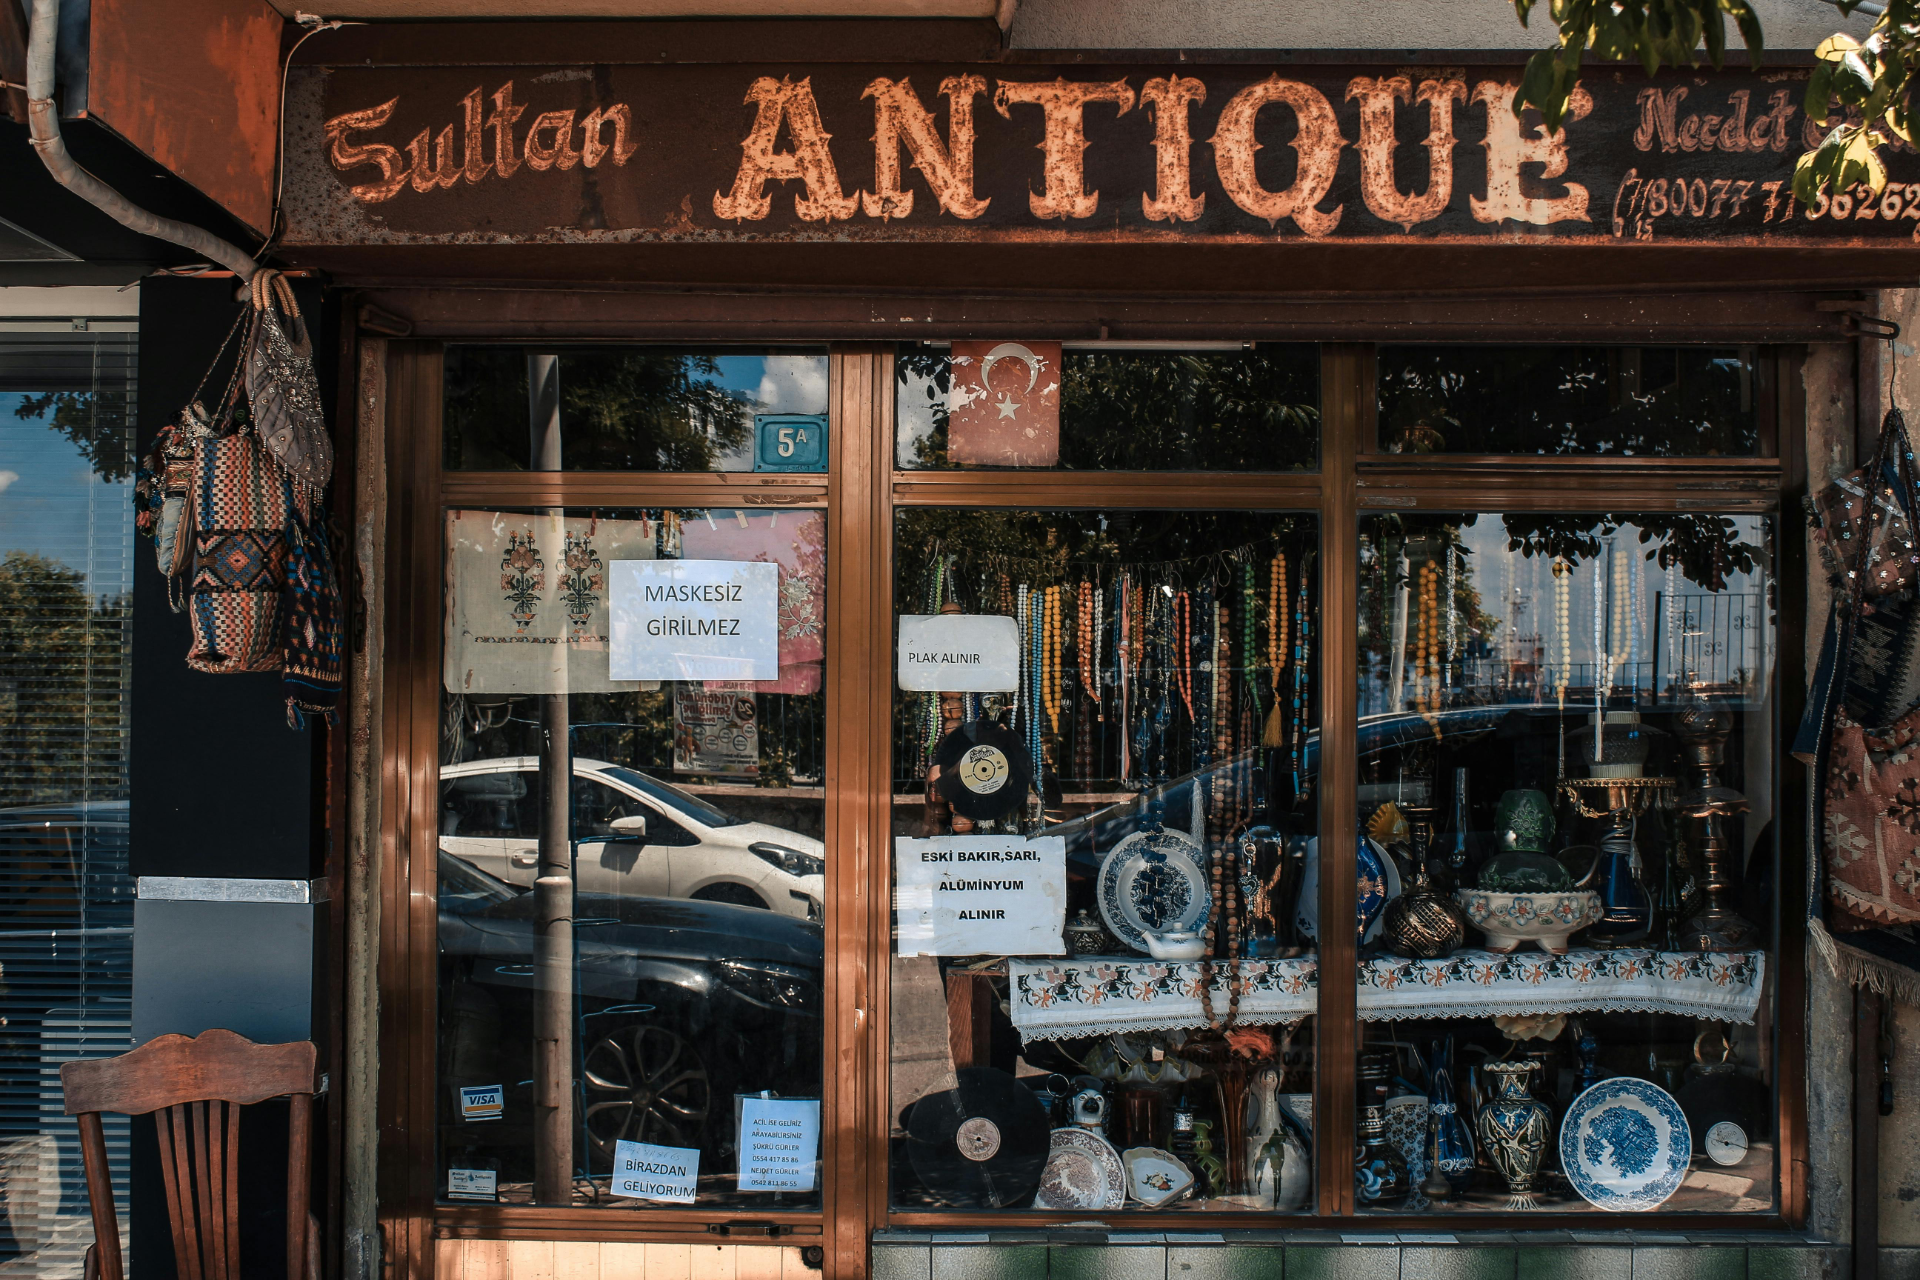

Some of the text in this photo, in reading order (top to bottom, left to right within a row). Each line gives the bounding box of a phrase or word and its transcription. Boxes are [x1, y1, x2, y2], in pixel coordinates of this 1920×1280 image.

[324, 79, 638, 202] Sultan
[712, 71, 1594, 236] ANTIQUE
[644, 581, 743, 602] MASKESİZ
[646, 615, 741, 636] GİRİLMEZ
[908, 653, 981, 665] PLAK ALINIR
[921, 850, 953, 862] ESKİ
[938, 879, 1025, 892] ALÜMİNYUM
[958, 909, 1006, 920] ALINIR
[469, 1094, 496, 1106] VISA
[625, 1158, 687, 1177] BİRAZDAN
[623, 1180, 696, 1198] GELİYORUM
